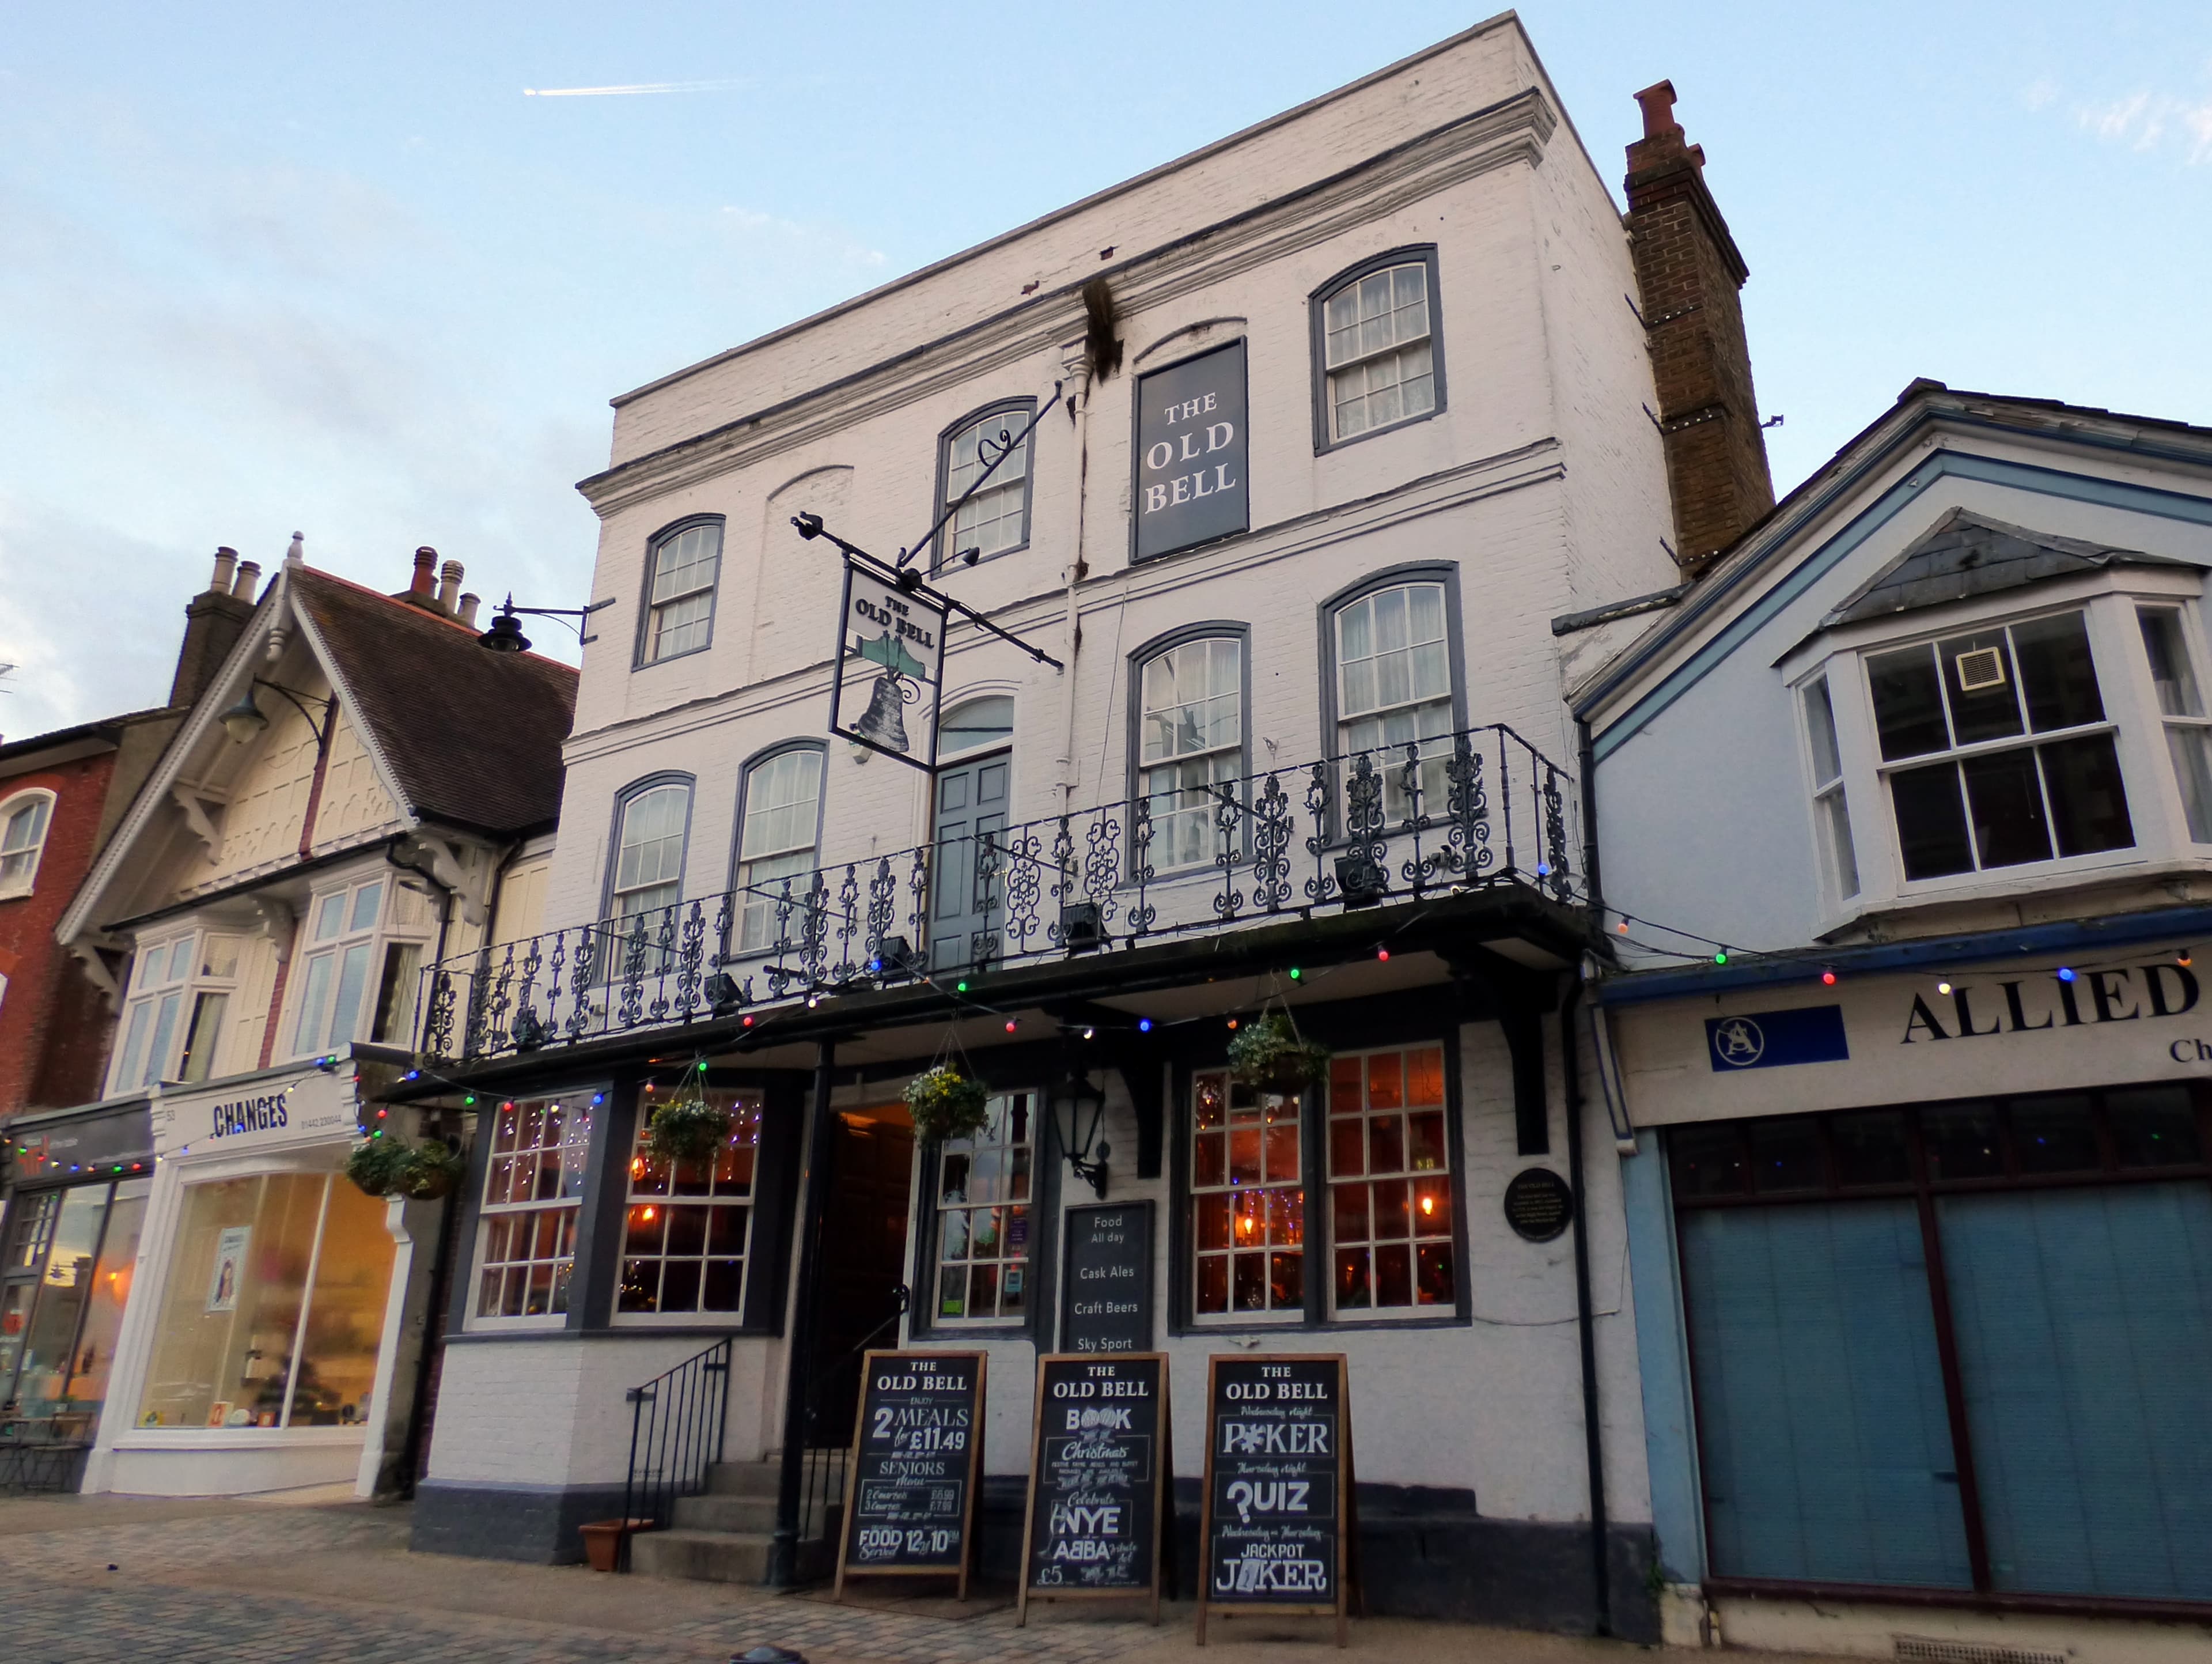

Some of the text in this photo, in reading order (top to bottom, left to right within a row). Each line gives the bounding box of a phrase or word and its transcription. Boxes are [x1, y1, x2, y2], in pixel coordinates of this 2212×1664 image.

[1164, 392, 1217, 425] THE
[1147, 422, 1234, 470] OLD
[1145, 463, 1236, 515] BELL
[885, 596, 909, 617] THE
[856, 599, 934, 649] OLD BELL
[1900, 963, 2200, 1045] ALLIED
[214, 1093, 287, 1137] CHANGES
[1094, 1215, 1123, 1228] Food
[1091, 1232, 1124, 1243] All day
[1080, 1266, 1134, 1279] Cask Ales
[1074, 1302, 1138, 1314] Craft Beers
[1078, 1337, 1132, 1353] Sky Sport
[911, 1362, 936, 1371] THE
[1088, 1367, 1115, 1376] THE
[1262, 1367, 1291, 1378] THE
[877, 1375, 967, 1390] OLD BELL
[1054, 1382, 1149, 1398] OLD BELL
[1226, 1383, 1327, 1400] OLD BELL
[910, 1397, 933, 1405] ENJOY
[873, 1408, 968, 1438] 2 MEALS
[1066, 1408, 1131, 1429] BOOK
[910, 1427, 965, 1450] £11.49
[1062, 1441, 1129, 1461] Christmas
[880, 1461, 945, 1476] SENIORS
[1059, 1507, 1121, 1534] NYE
[859, 1529, 903, 1546] FOOD
[906, 1529, 924, 1552] 12
[1053, 1541, 1110, 1560] ABBA
[1241, 1544, 1305, 1559] JACKPOT
